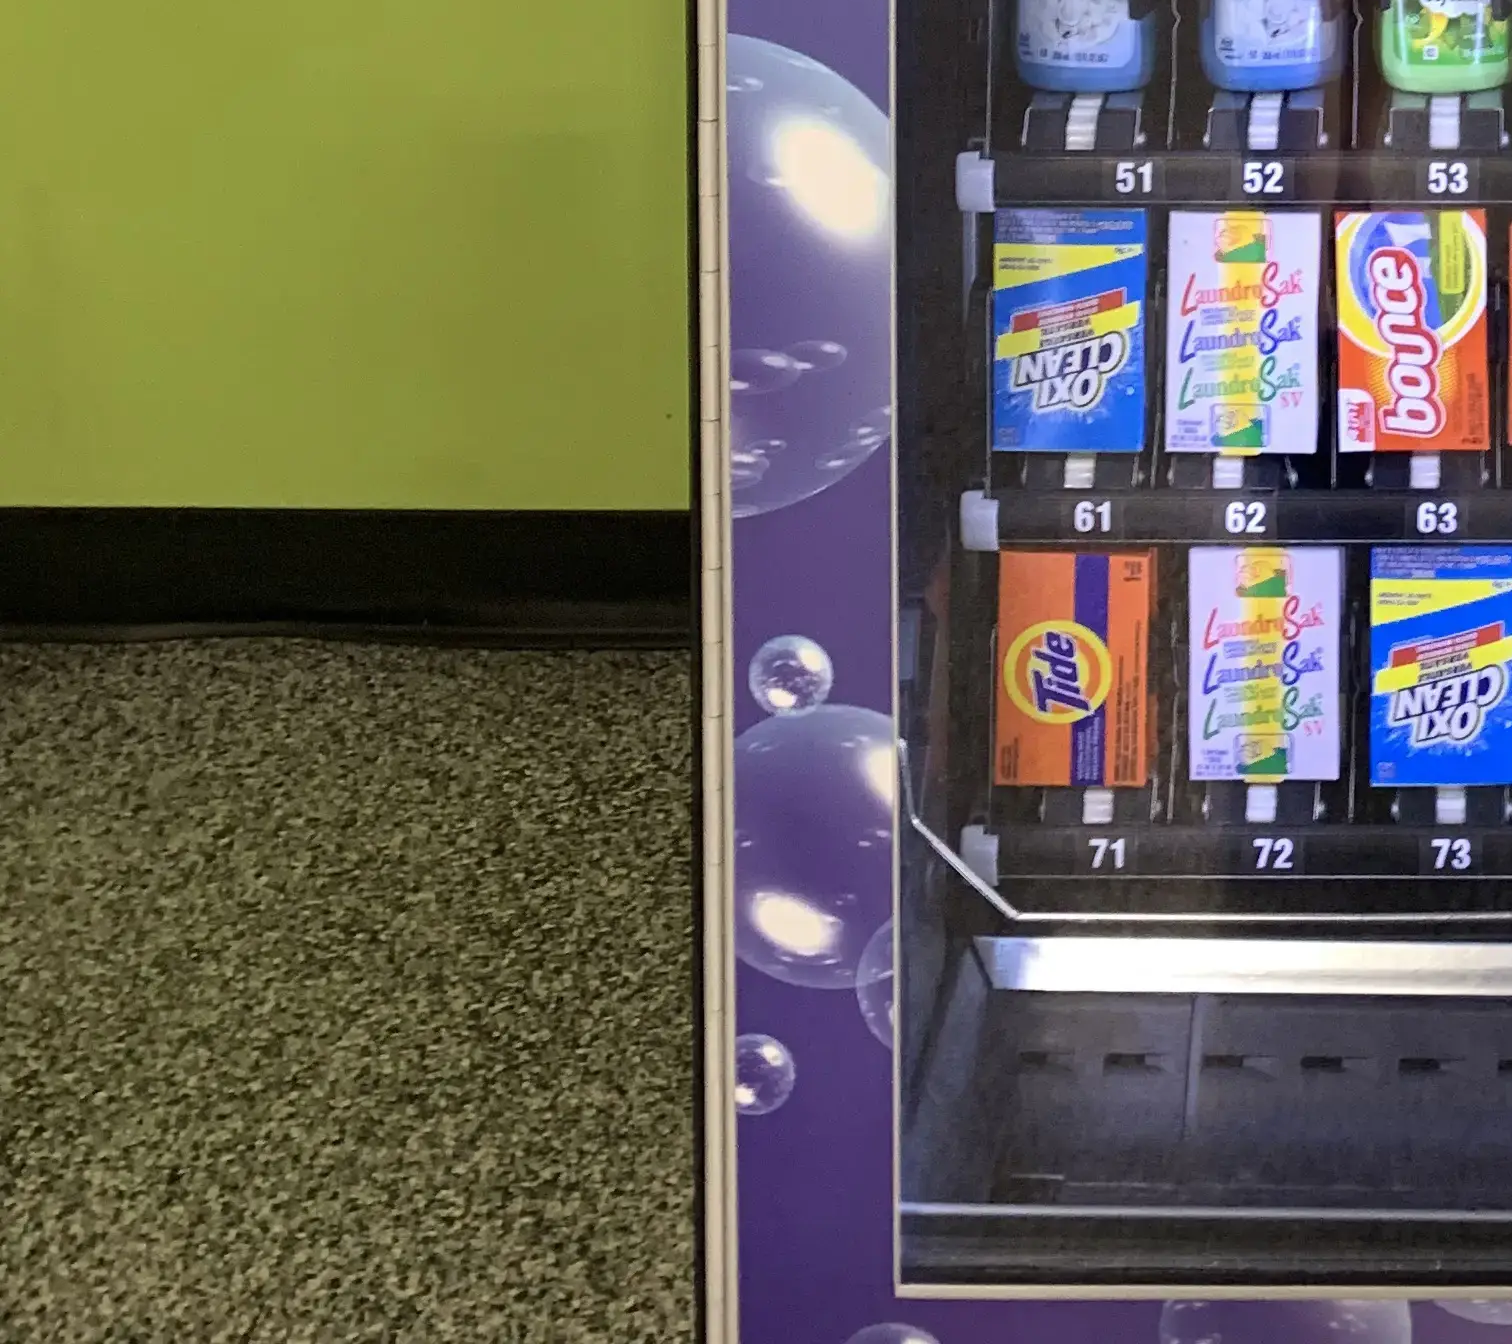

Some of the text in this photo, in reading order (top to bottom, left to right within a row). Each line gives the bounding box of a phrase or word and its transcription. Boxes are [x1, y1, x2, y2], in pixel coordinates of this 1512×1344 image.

[1116, 162, 1153, 193] 51
[1243, 161, 1284, 193] 52
[1428, 162, 1468, 194] 53
[1014, 331, 1125, 387] CLEAN
[1370, 254, 1438, 434] bounce
[1037, 368, 1101, 410] OXI
[1074, 500, 1111, 532] 61
[1225, 501, 1266, 533] 62
[1417, 501, 1457, 533] 63
[1033, 631, 1092, 713] Tide
[1391, 664, 1503, 723] CLEAN
[1416, 700, 1478, 743] OXI
[1088, 838, 1125, 868] 71
[1253, 838, 1294, 869] 72
[1431, 838, 1471, 869] 73
